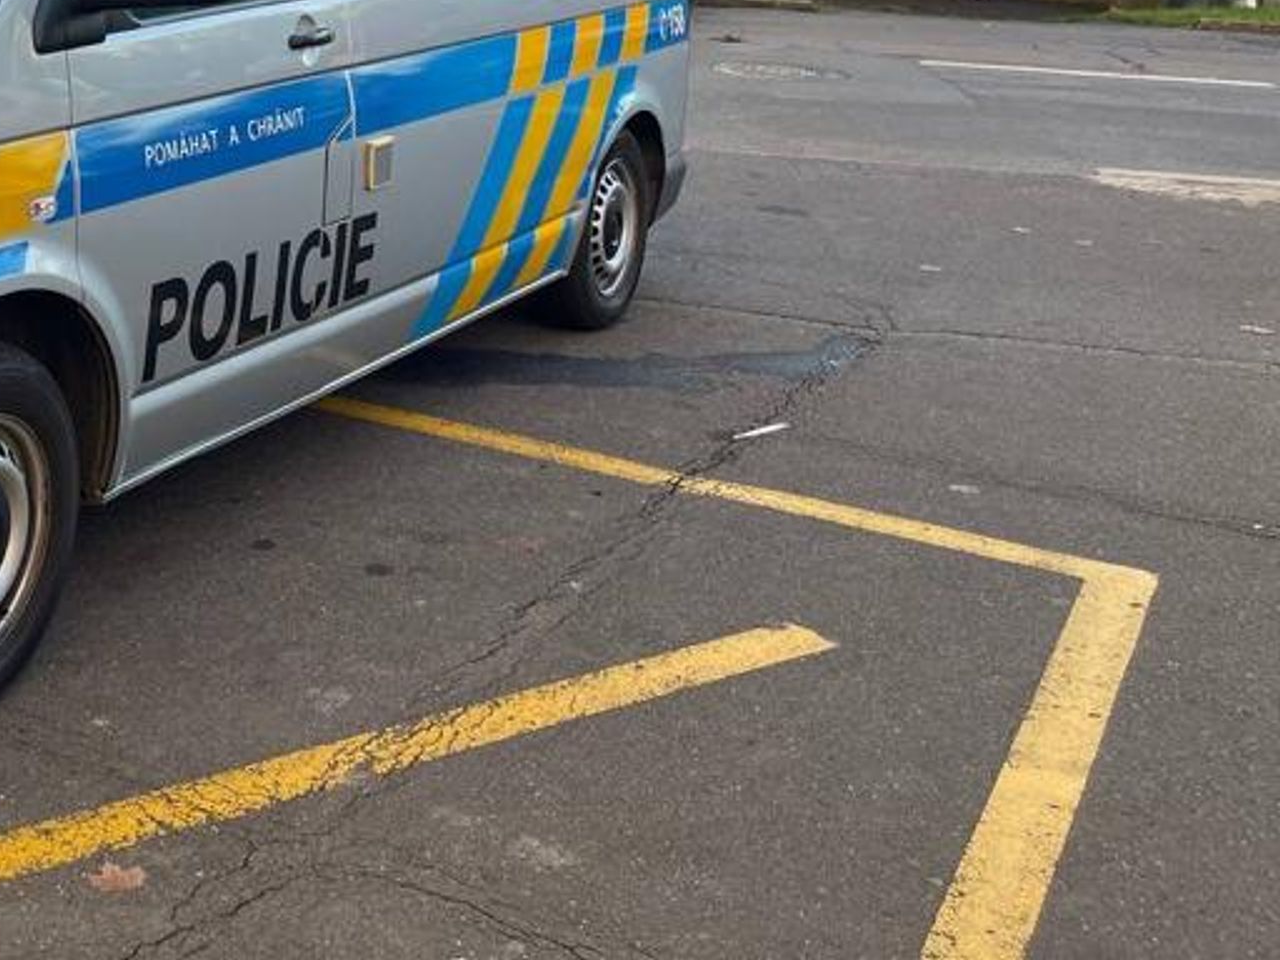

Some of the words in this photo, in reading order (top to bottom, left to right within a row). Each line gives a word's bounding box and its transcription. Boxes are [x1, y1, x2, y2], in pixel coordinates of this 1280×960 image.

[144, 129, 219, 169] POMÁHAT
[229, 124, 240, 147] A
[247, 106, 306, 142] CHRÁNIT
[141, 211, 378, 383] POLICIE
